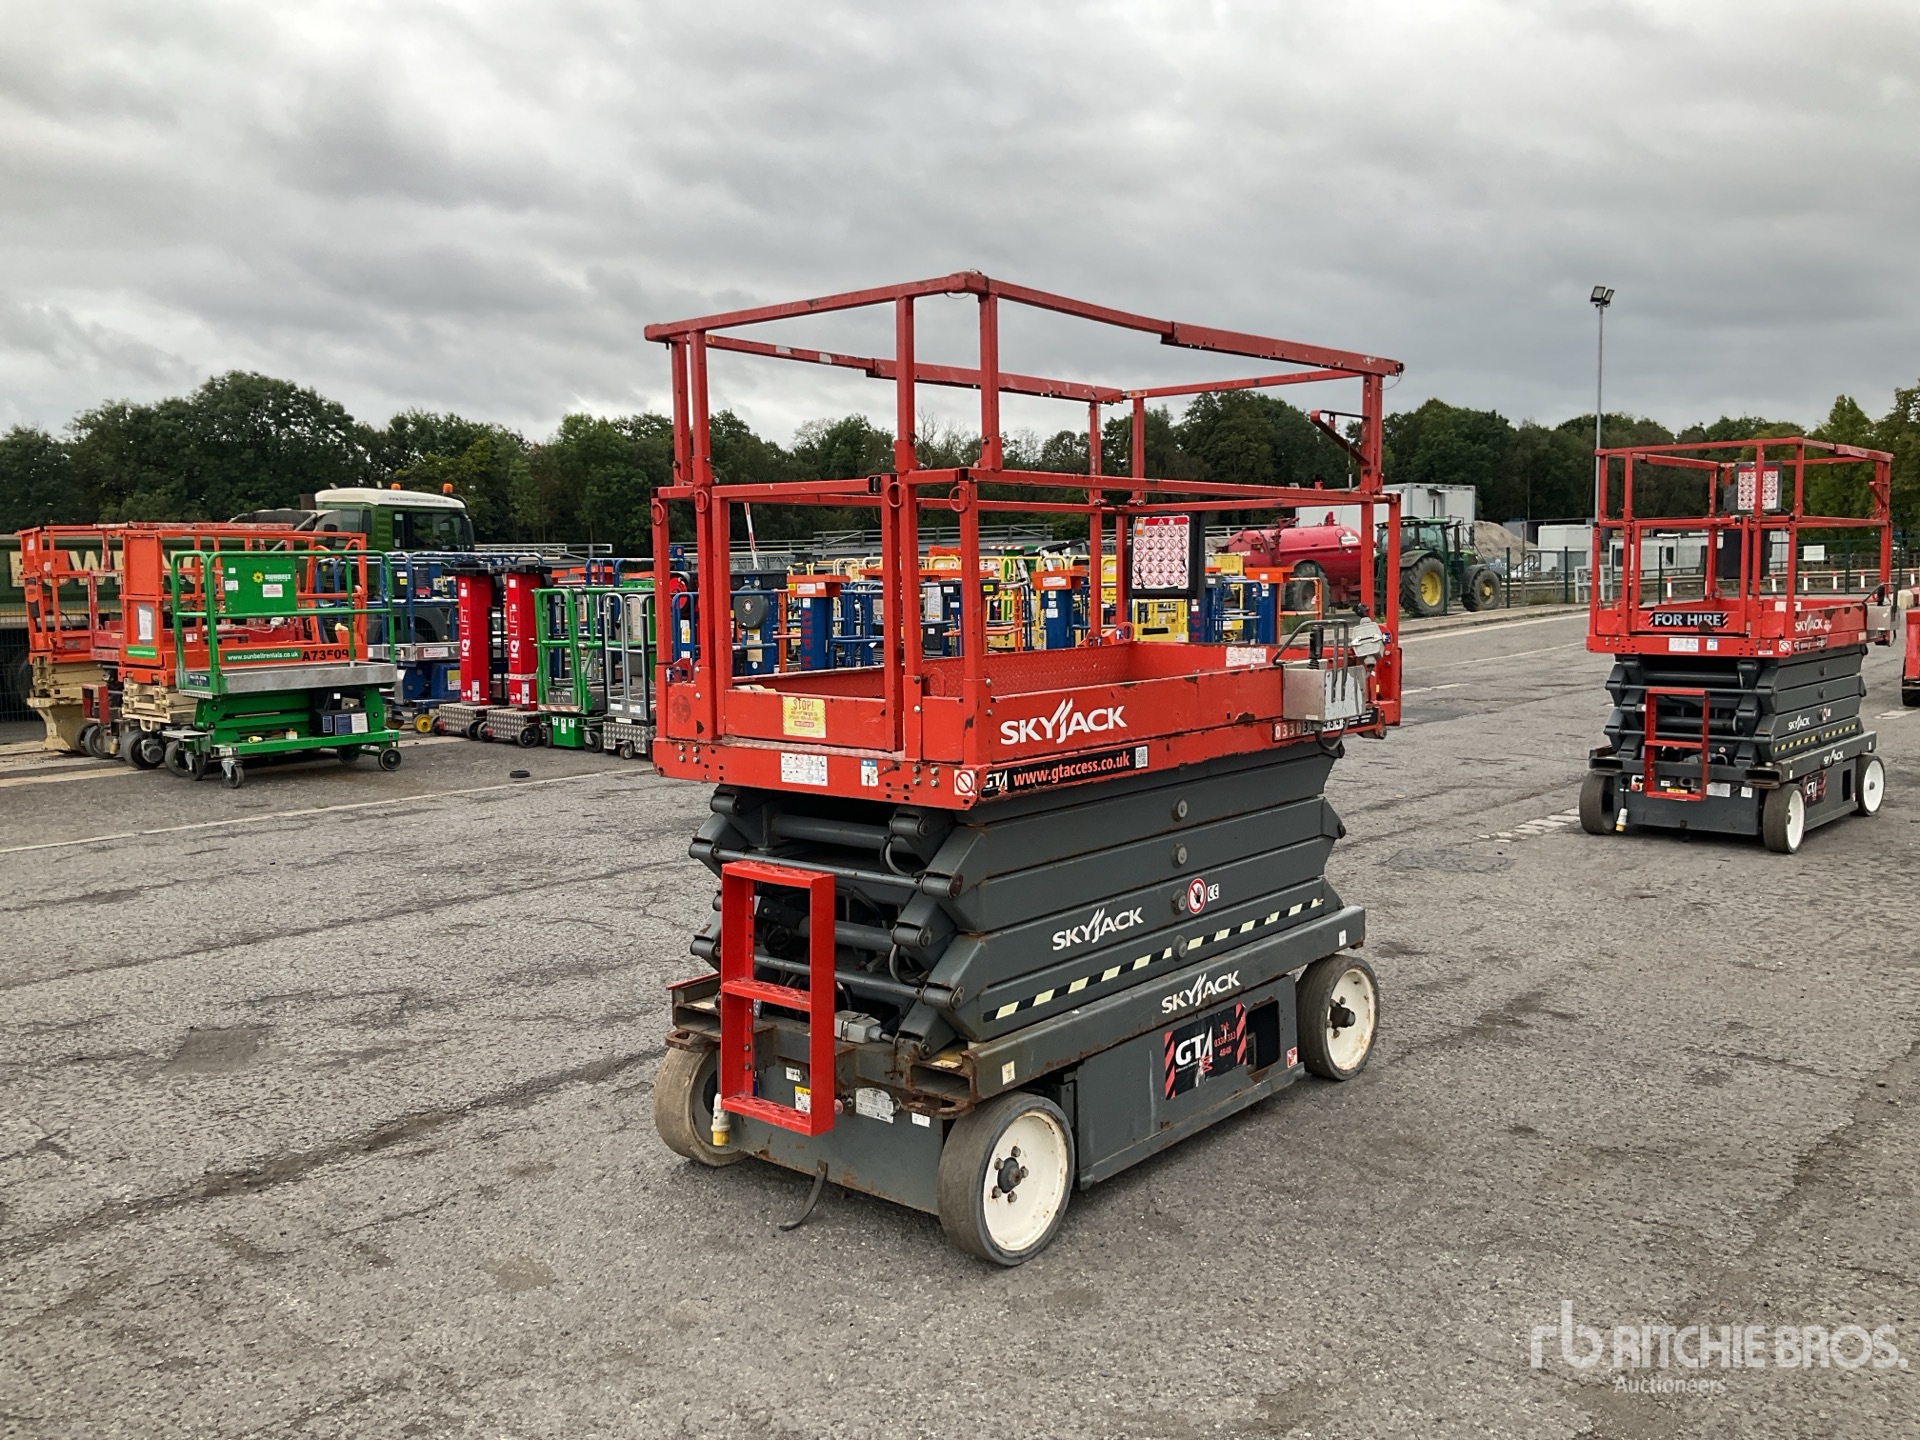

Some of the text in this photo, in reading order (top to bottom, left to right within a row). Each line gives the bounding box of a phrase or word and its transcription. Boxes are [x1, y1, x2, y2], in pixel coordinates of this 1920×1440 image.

[460, 606, 470, 636] LIFT
[508, 605, 519, 637] LIFT
[1654, 613, 1722, 626] FOR HIRE
[227, 650, 299, 661] www.sunbeltrentals.co.uk
[793, 698, 815, 711] STOP!
[1000, 698, 1127, 745] SKYJACK
[1013, 751, 1130, 787] www.gtaccess.co.uk
[1208, 883, 1219, 900] CE
[1052, 906, 1144, 951] SKYJACK
[1161, 969, 1241, 1014] SKYJACK
